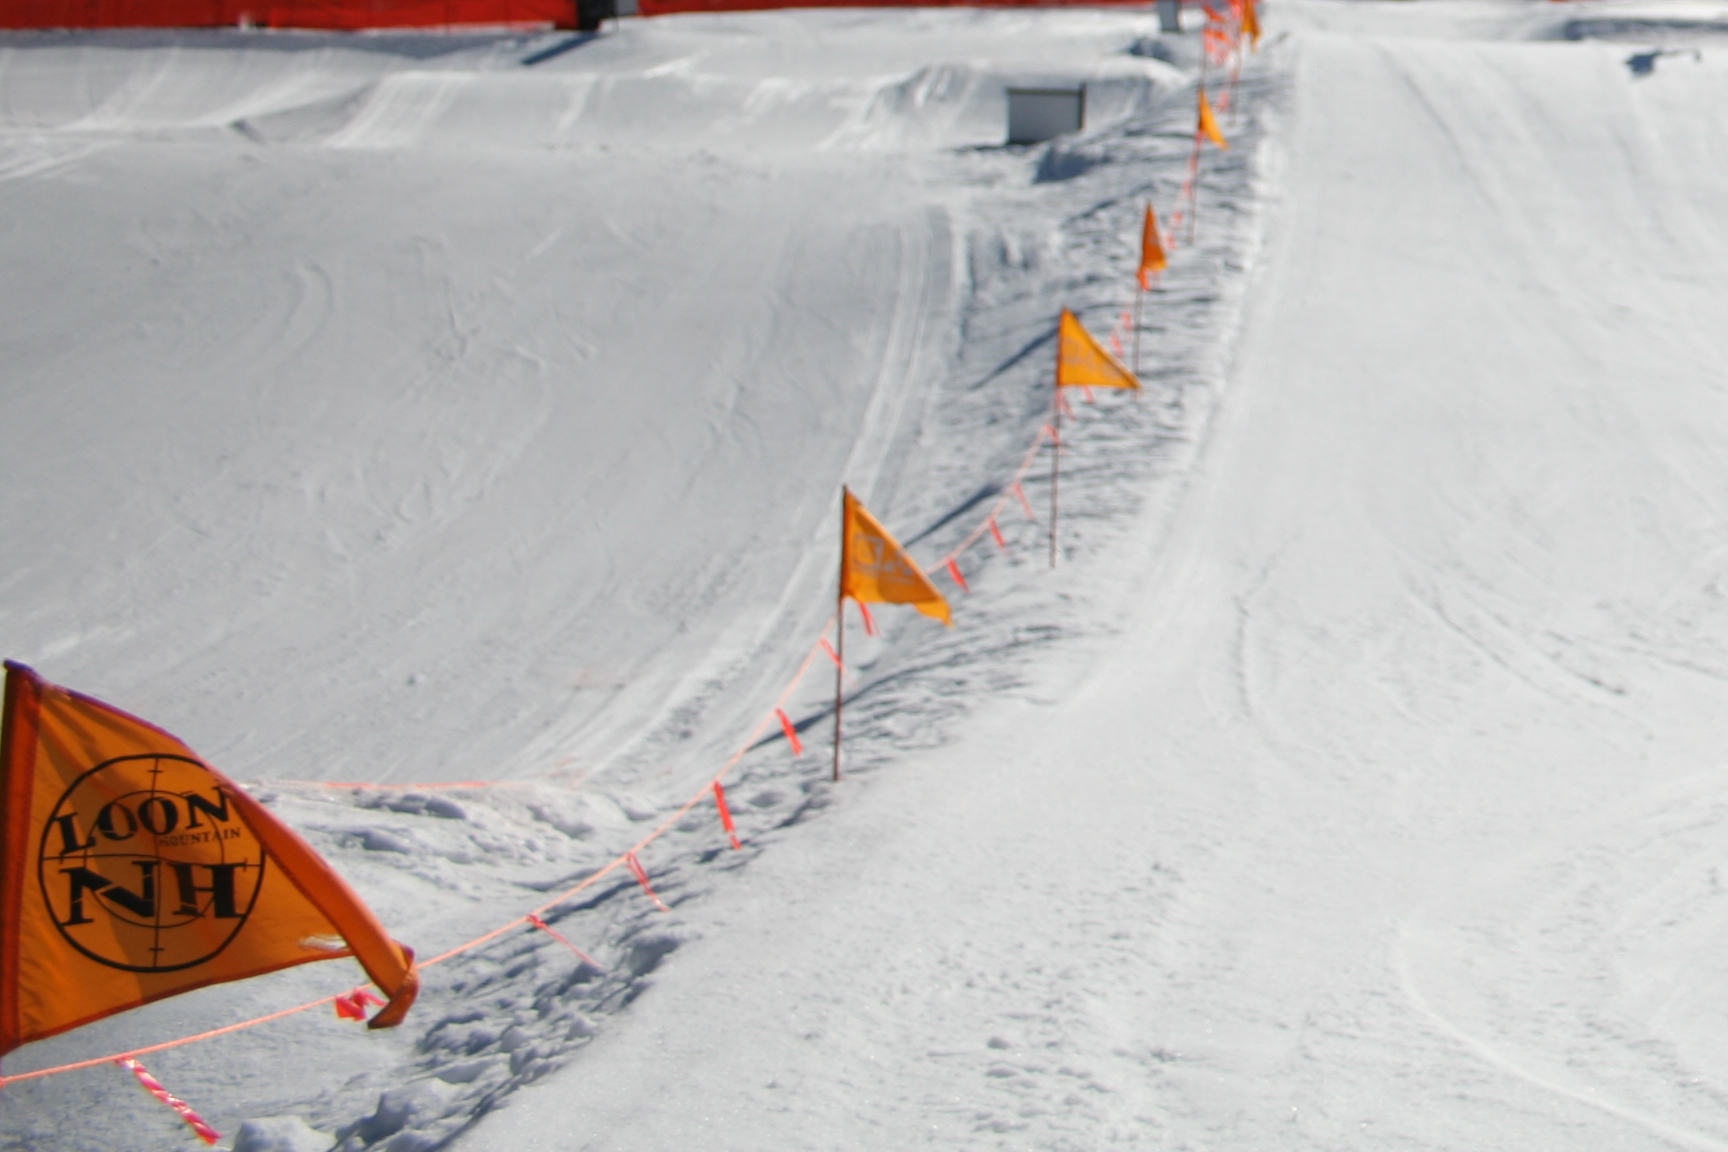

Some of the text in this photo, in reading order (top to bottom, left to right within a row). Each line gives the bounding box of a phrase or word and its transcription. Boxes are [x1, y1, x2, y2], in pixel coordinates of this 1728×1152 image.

[53, 784, 231, 856] LOON
[158, 827, 241, 847] MOUNTAIN
[58, 860, 248, 927] NH
